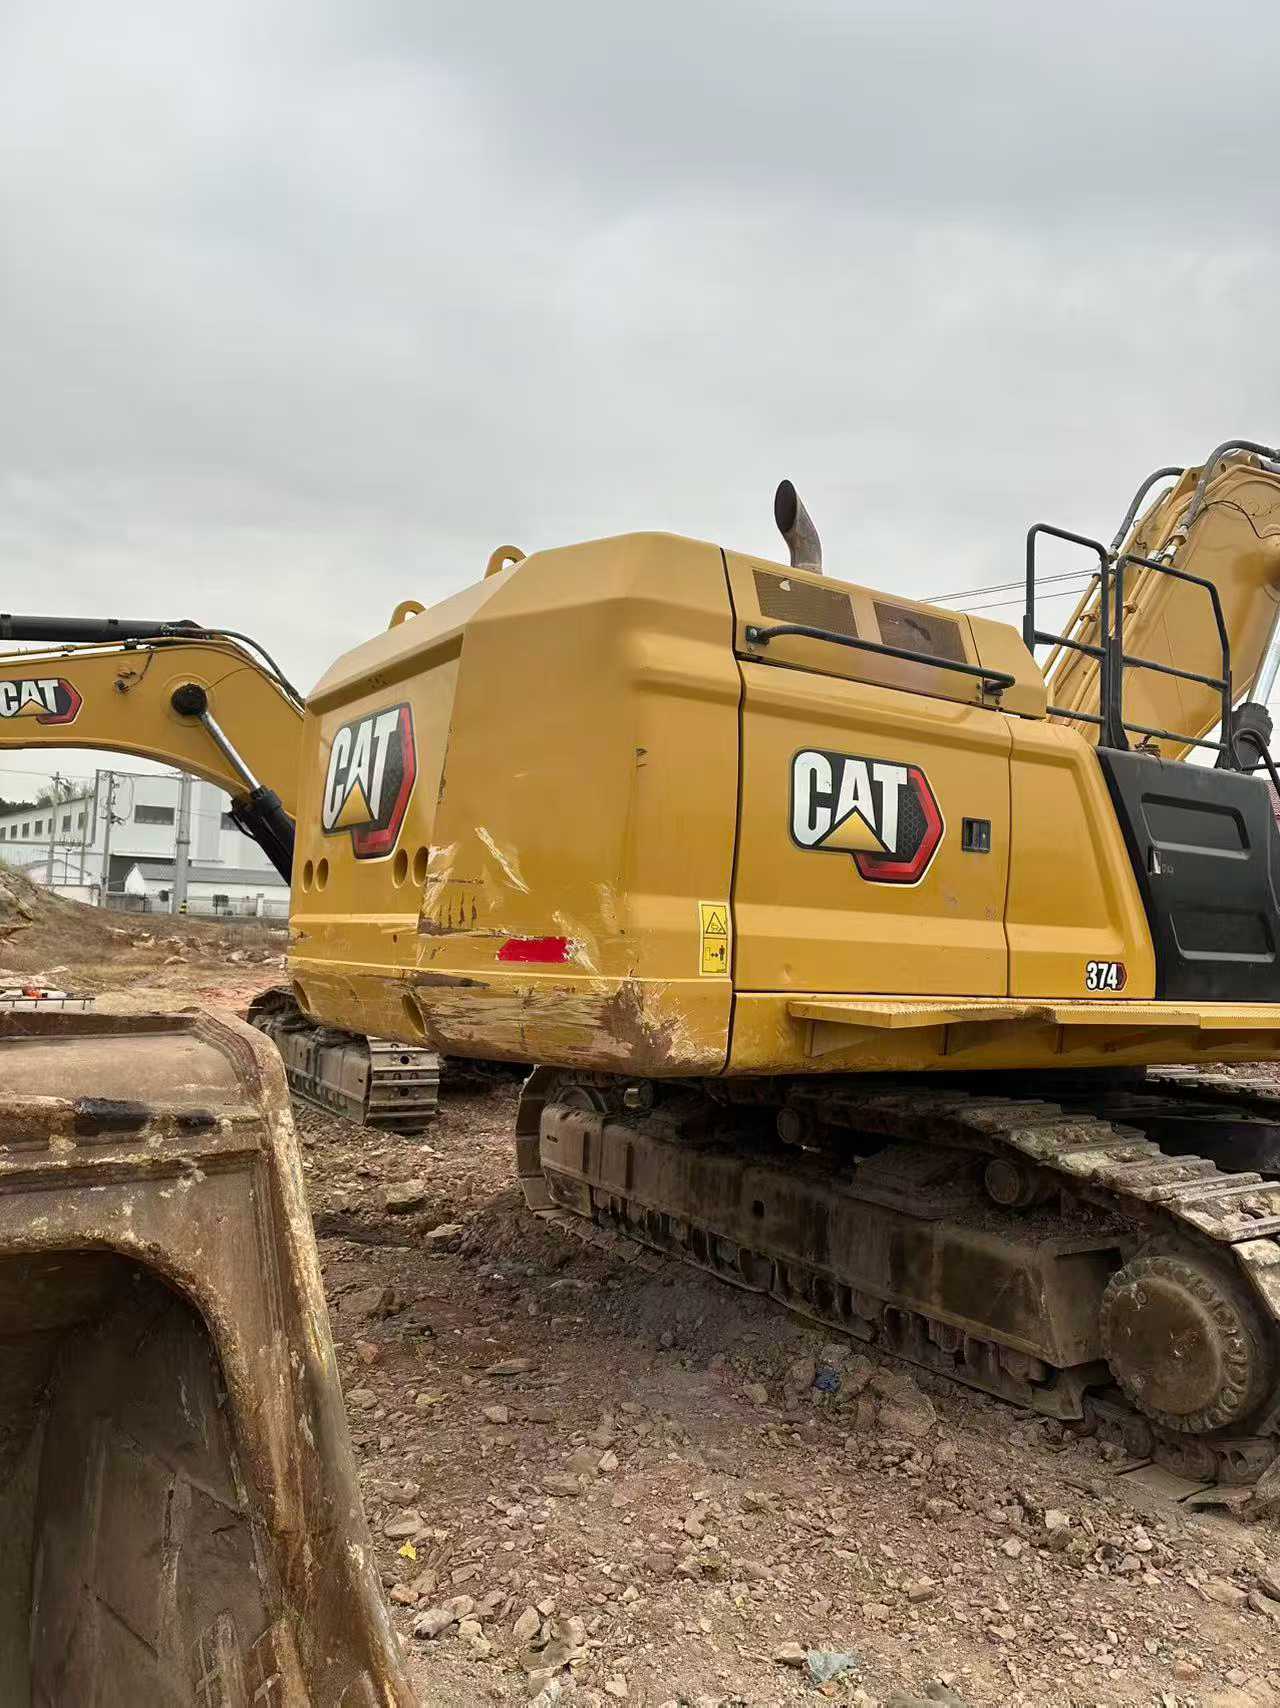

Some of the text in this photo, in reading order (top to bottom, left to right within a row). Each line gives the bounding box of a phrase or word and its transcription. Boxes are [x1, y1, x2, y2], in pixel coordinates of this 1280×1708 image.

[0, 679, 59, 717] CAT
[322, 708, 400, 829] CAT
[793, 751, 908, 853] CAT
[1086, 962, 1118, 989] 374
